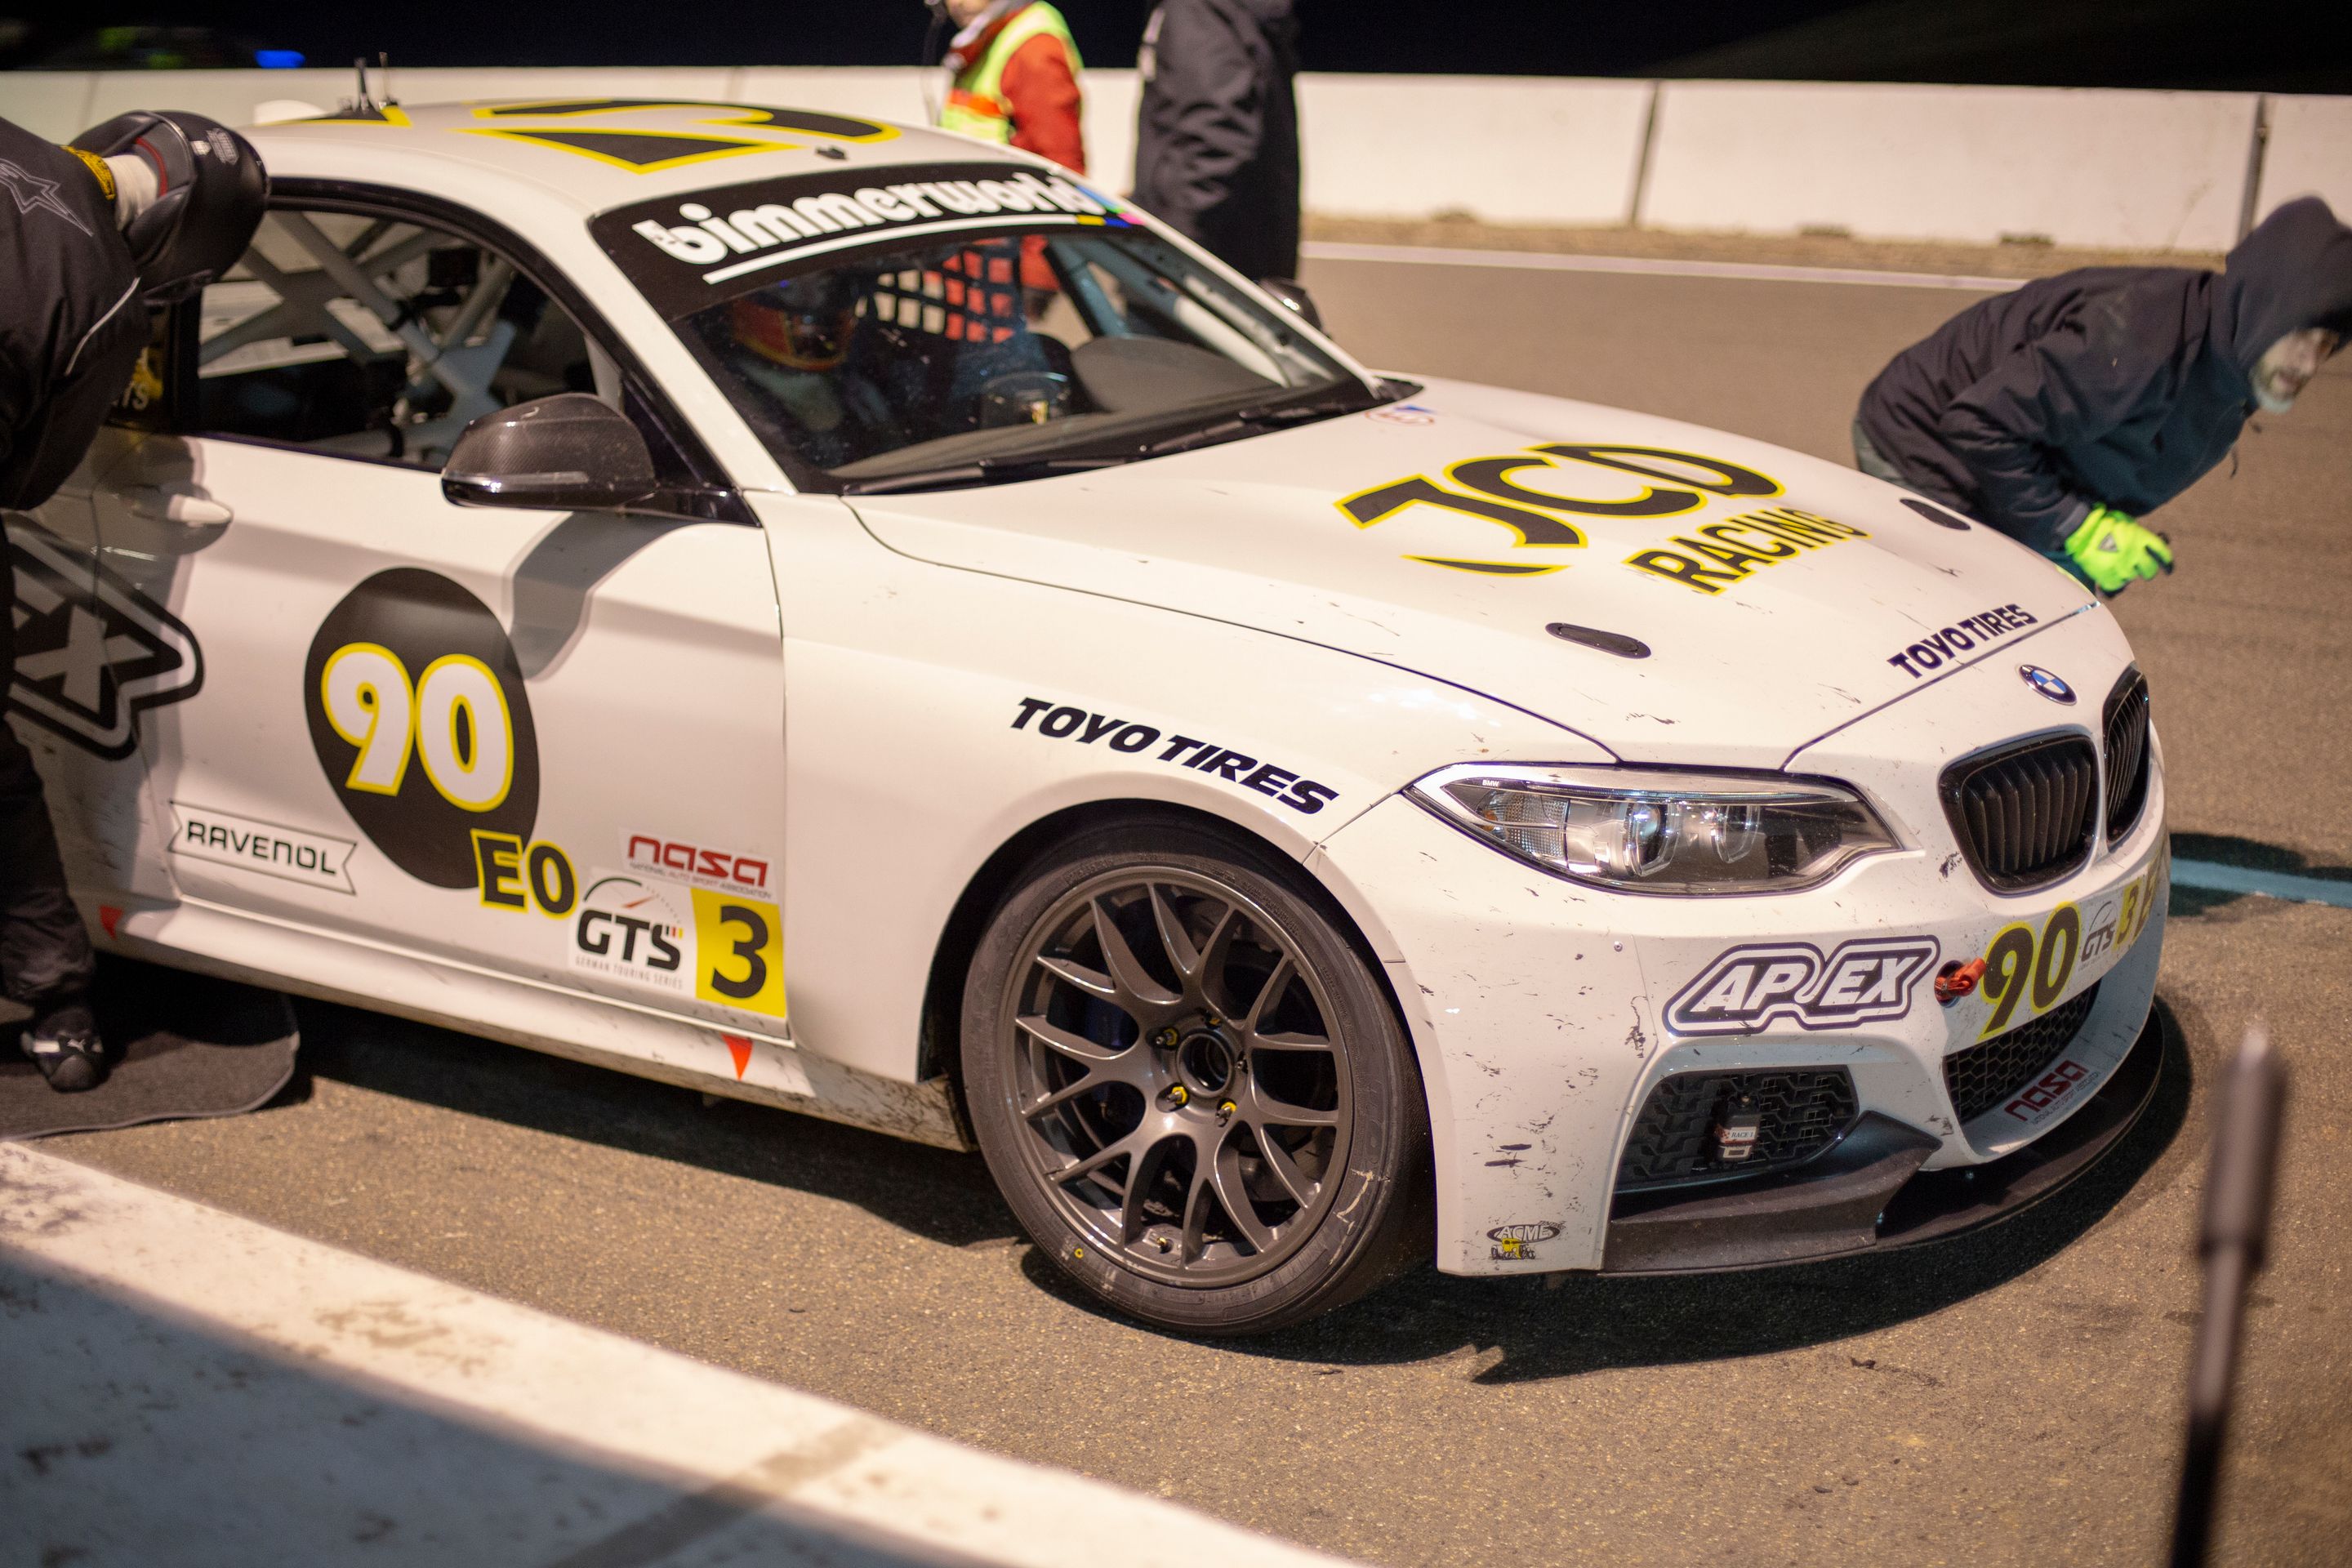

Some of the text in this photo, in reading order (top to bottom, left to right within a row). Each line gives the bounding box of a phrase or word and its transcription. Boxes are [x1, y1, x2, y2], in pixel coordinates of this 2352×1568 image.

[631, 172, 1107, 264] bimmerworld
[1333, 442, 1786, 577] JCD
[1621, 506, 1872, 595] RACING
[1886, 604, 2038, 679] TOYO TIRES
[321, 642, 514, 813] 90
[1010, 697, 1340, 815] TOYO TIRES
[1481, 779, 1499, 787] BMW
[187, 820, 336, 875] RAVENOL
[628, 835, 768, 887] nasa
[577, 909, 683, 971] GTS
[711, 904, 769, 1000] 3
[1976, 901, 2082, 1043] 90
[2081, 919, 2117, 962] GTS
[1684, 951, 1925, 1017] APEX
[2004, 1060, 2089, 1122] nasa
[1495, 1225, 1550, 1241] ACME
